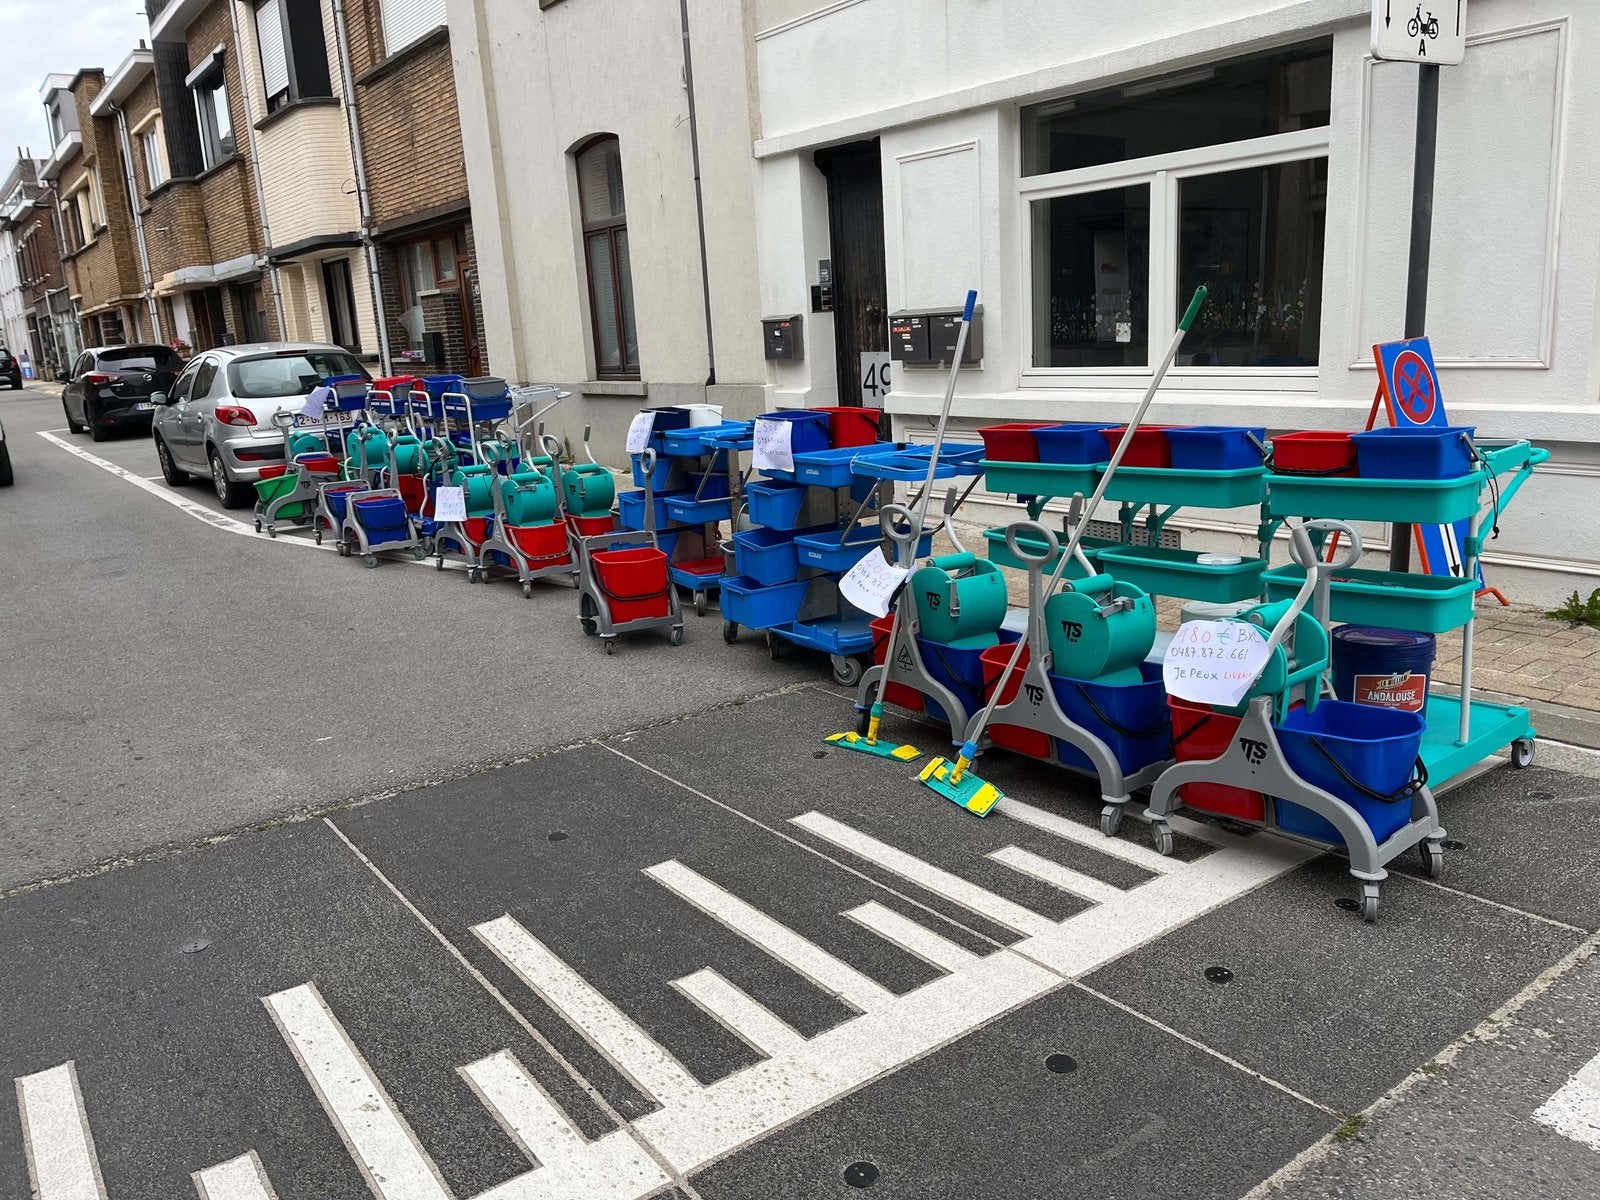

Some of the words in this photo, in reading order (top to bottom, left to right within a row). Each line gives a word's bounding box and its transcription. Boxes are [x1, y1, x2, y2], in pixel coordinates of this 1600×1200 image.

[1418, 38, 1426, 56] A
[863, 362, 891, 397] 49
[1061, 620, 1083, 641] TTS
[1173, 667, 1187, 680] JE
[1024, 683, 1045, 704] TTS
[1367, 690, 1416, 702] ANDALOUSE
[1239, 737, 1268, 762] TTS
